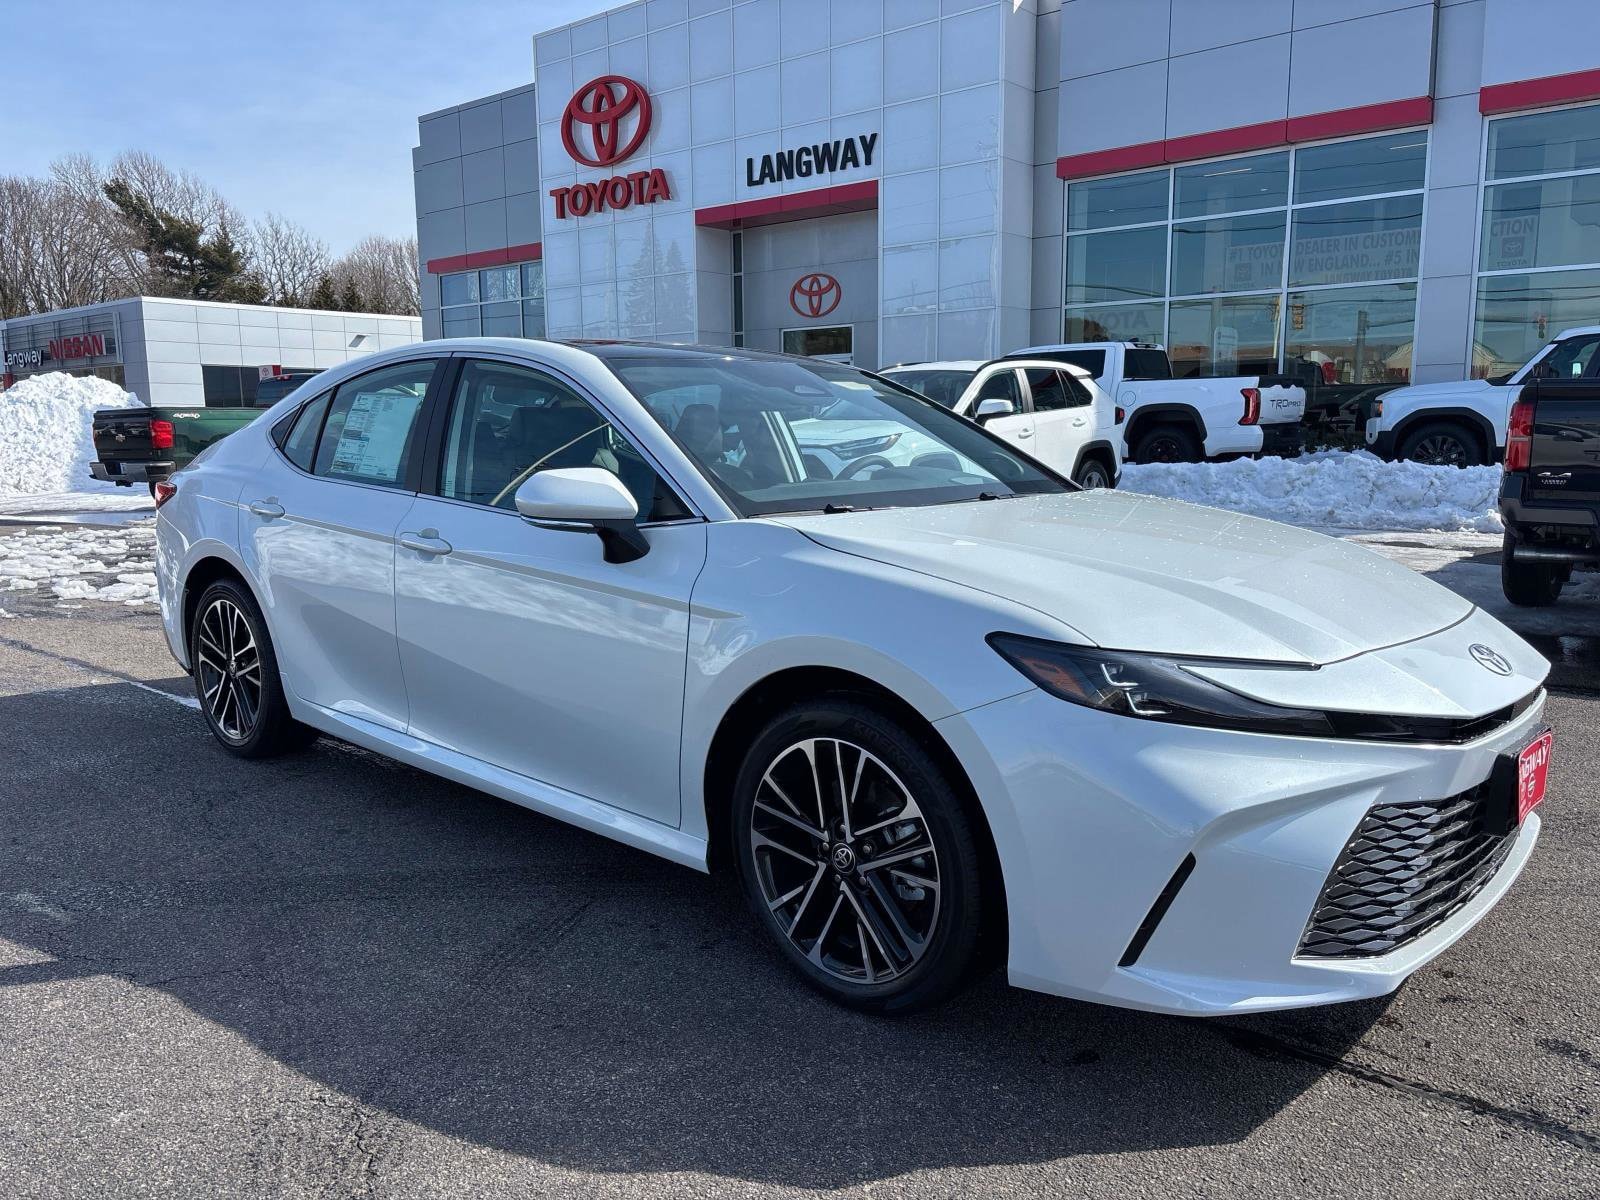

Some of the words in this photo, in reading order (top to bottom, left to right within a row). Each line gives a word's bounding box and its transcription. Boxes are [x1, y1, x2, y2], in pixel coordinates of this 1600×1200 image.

[746, 132, 878, 187] LANGWAY
[550, 168, 672, 219] TOYOTA
[1491, 217, 1534, 237] CTION
[1248, 244, 1283, 261] TOYOT
[1296, 238, 1340, 256] DEALER
[1344, 236, 1358, 252] IN
[1363, 230, 1420, 250] CUSTOM
[1260, 262, 1274, 277] IN
[1308, 253, 1380, 273] ENGLAND...
[1384, 249, 1402, 266] #5
[1088, 311, 1150, 330] YOTA
[3, 350, 43, 368] Langway
[49, 335, 106, 359] NISSAN
